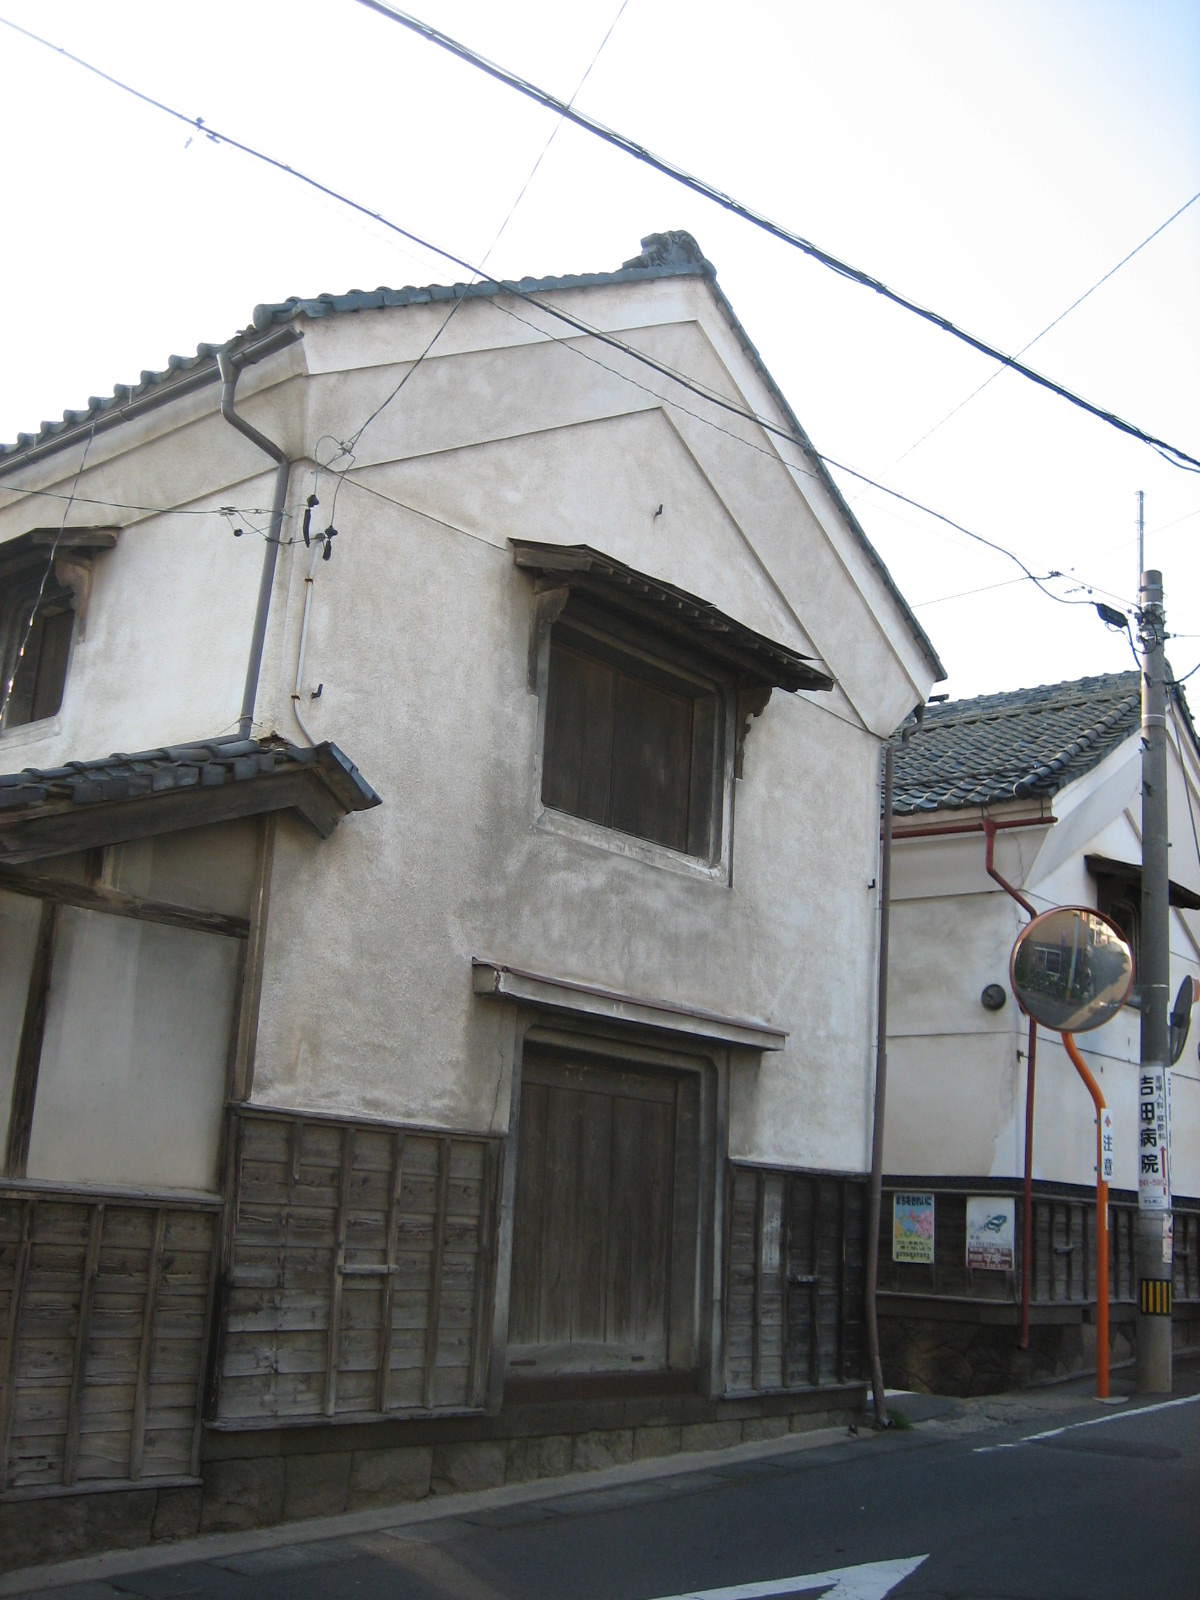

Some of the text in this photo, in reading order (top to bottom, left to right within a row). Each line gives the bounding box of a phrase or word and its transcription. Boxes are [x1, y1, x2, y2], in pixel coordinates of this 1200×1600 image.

[1104, 1134, 1113, 1176] 注意
[1141, 1075, 1159, 1174] 吉田病院
